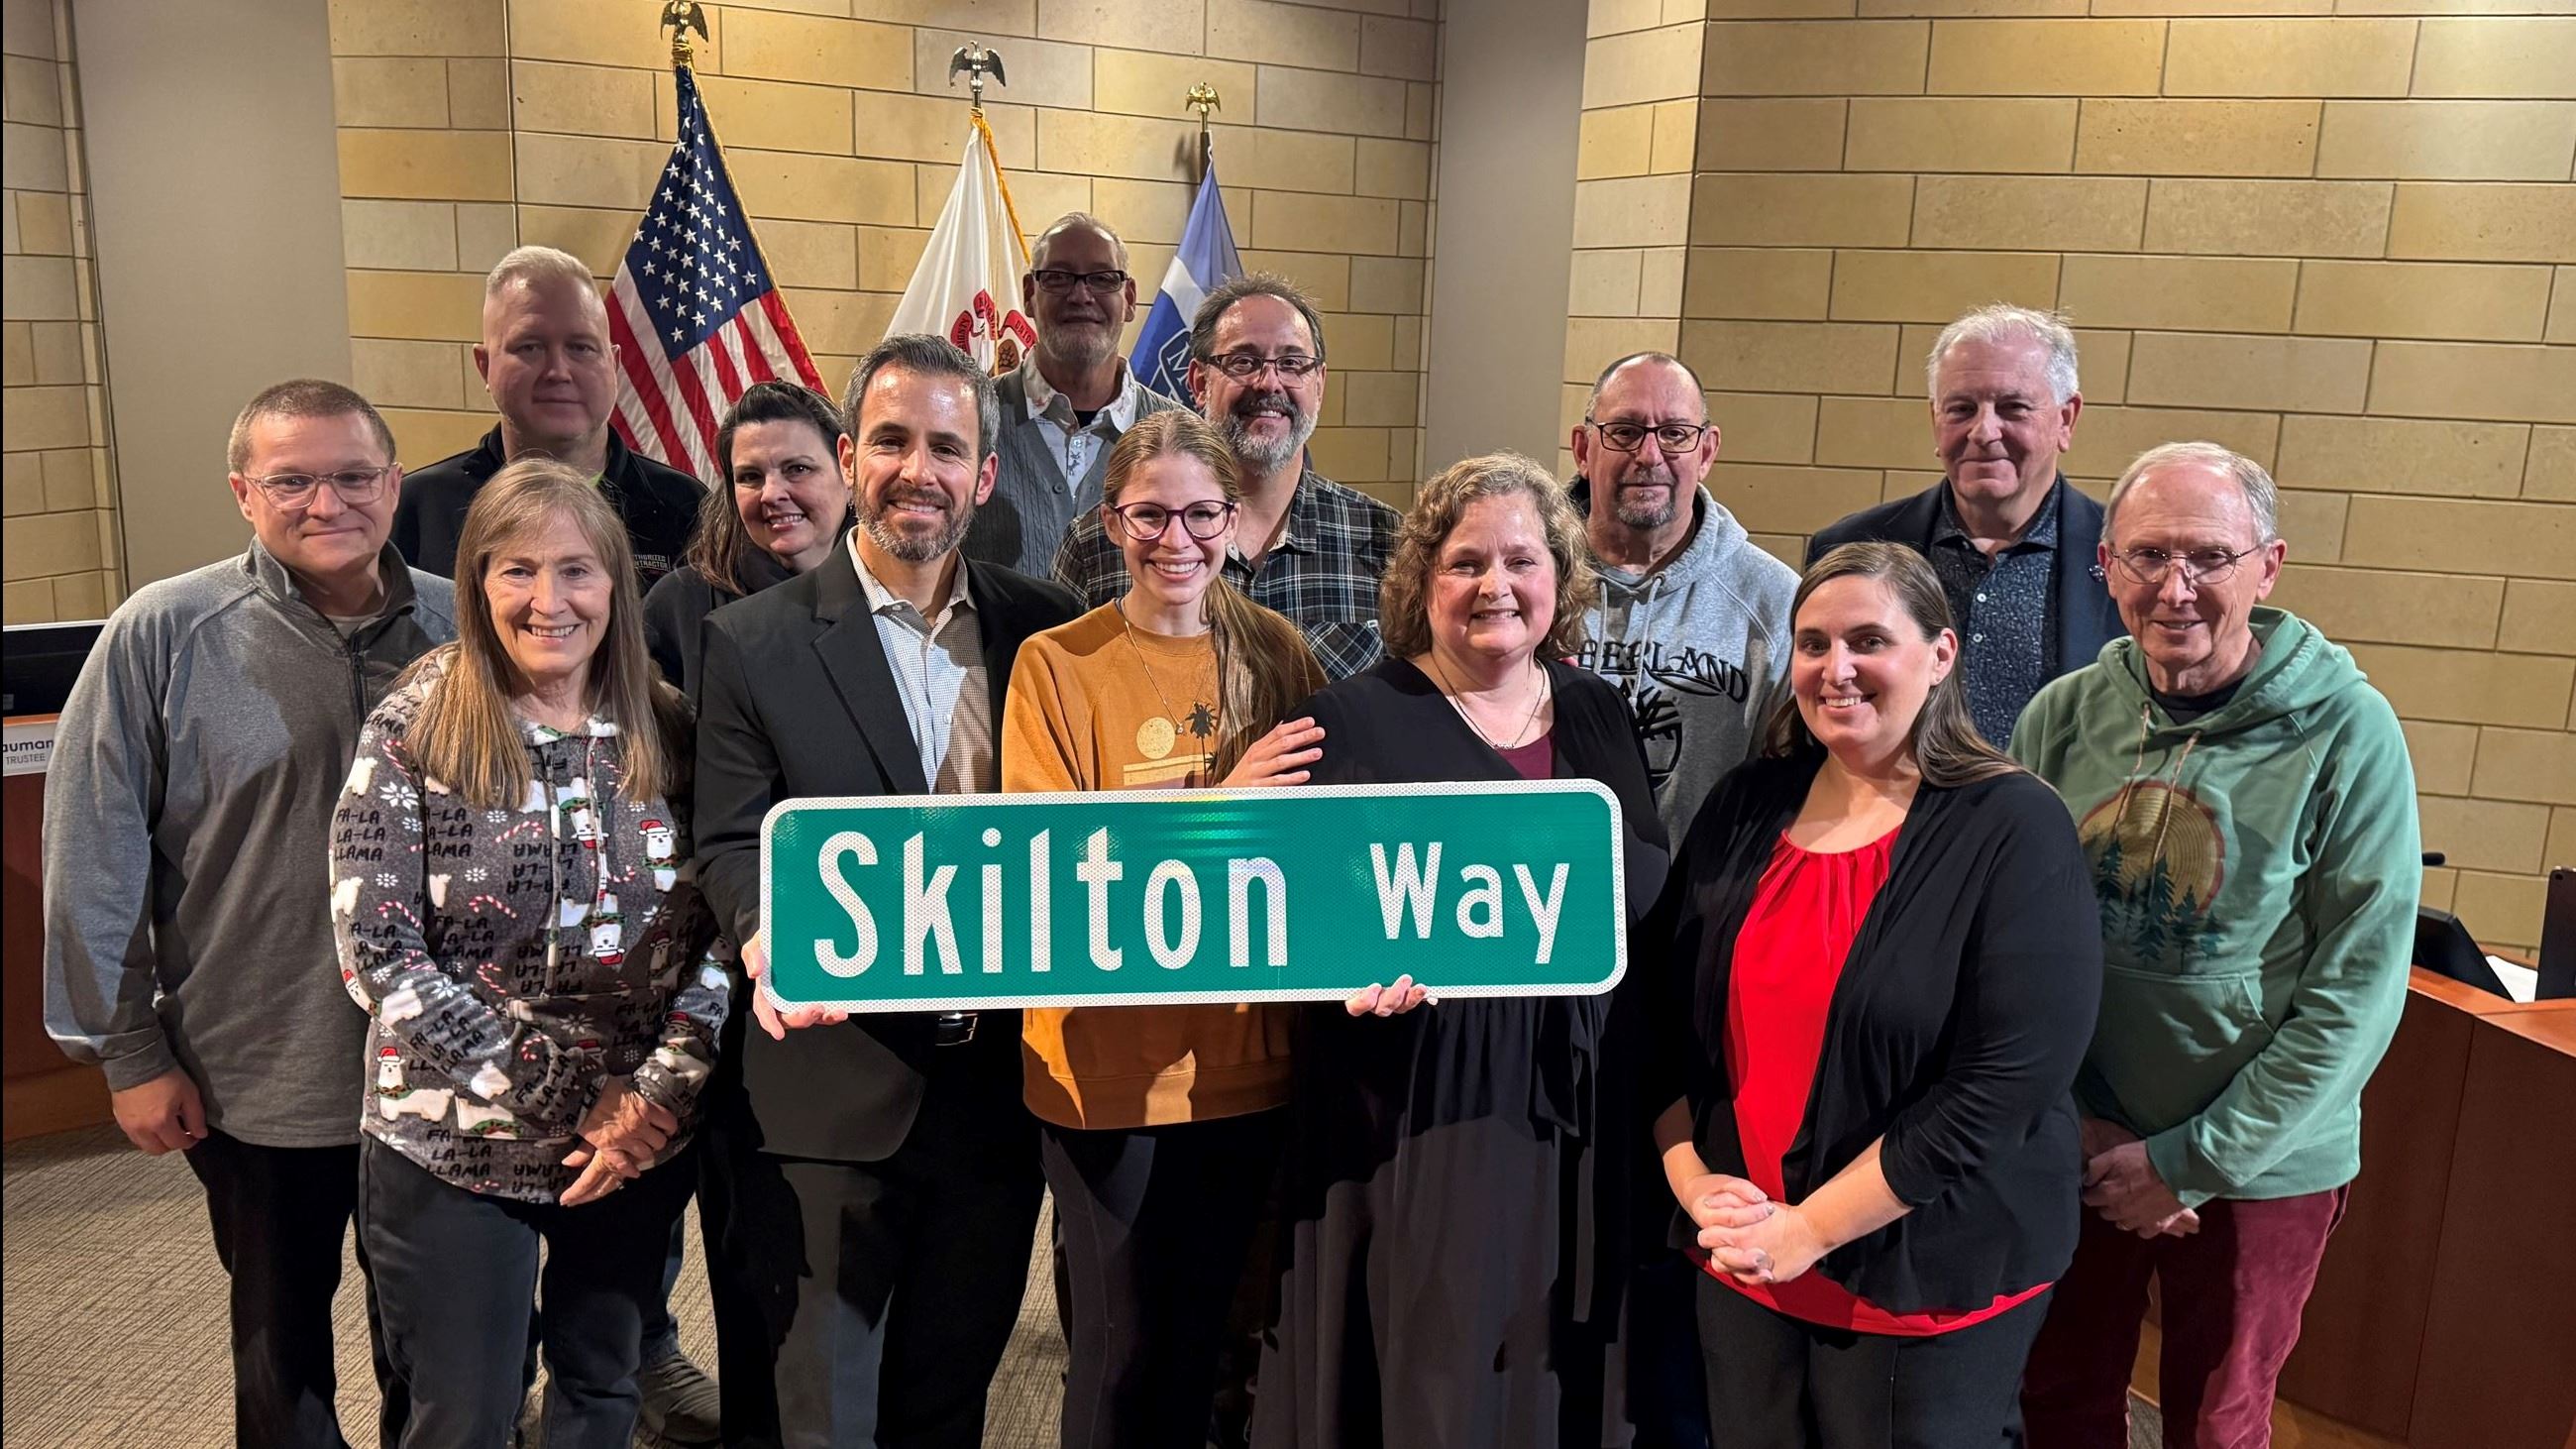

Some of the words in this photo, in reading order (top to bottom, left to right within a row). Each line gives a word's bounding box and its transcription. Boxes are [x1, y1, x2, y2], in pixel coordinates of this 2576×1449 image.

[1014, 319, 1037, 347] UNIO
[5, 753, 46, 765] TRUSTEE
[337, 808, 379, 824] FA-LA
[425, 807, 467, 822] A-LA
[337, 828, 385, 843] LA-LA
[427, 824, 473, 839] A-LA
[814, 827, 1288, 978] Skilton
[1370, 840, 1569, 964] Way
[409, 1010, 455, 1051] FA-LA
[432, 1145, 491, 1161] LA-LA
